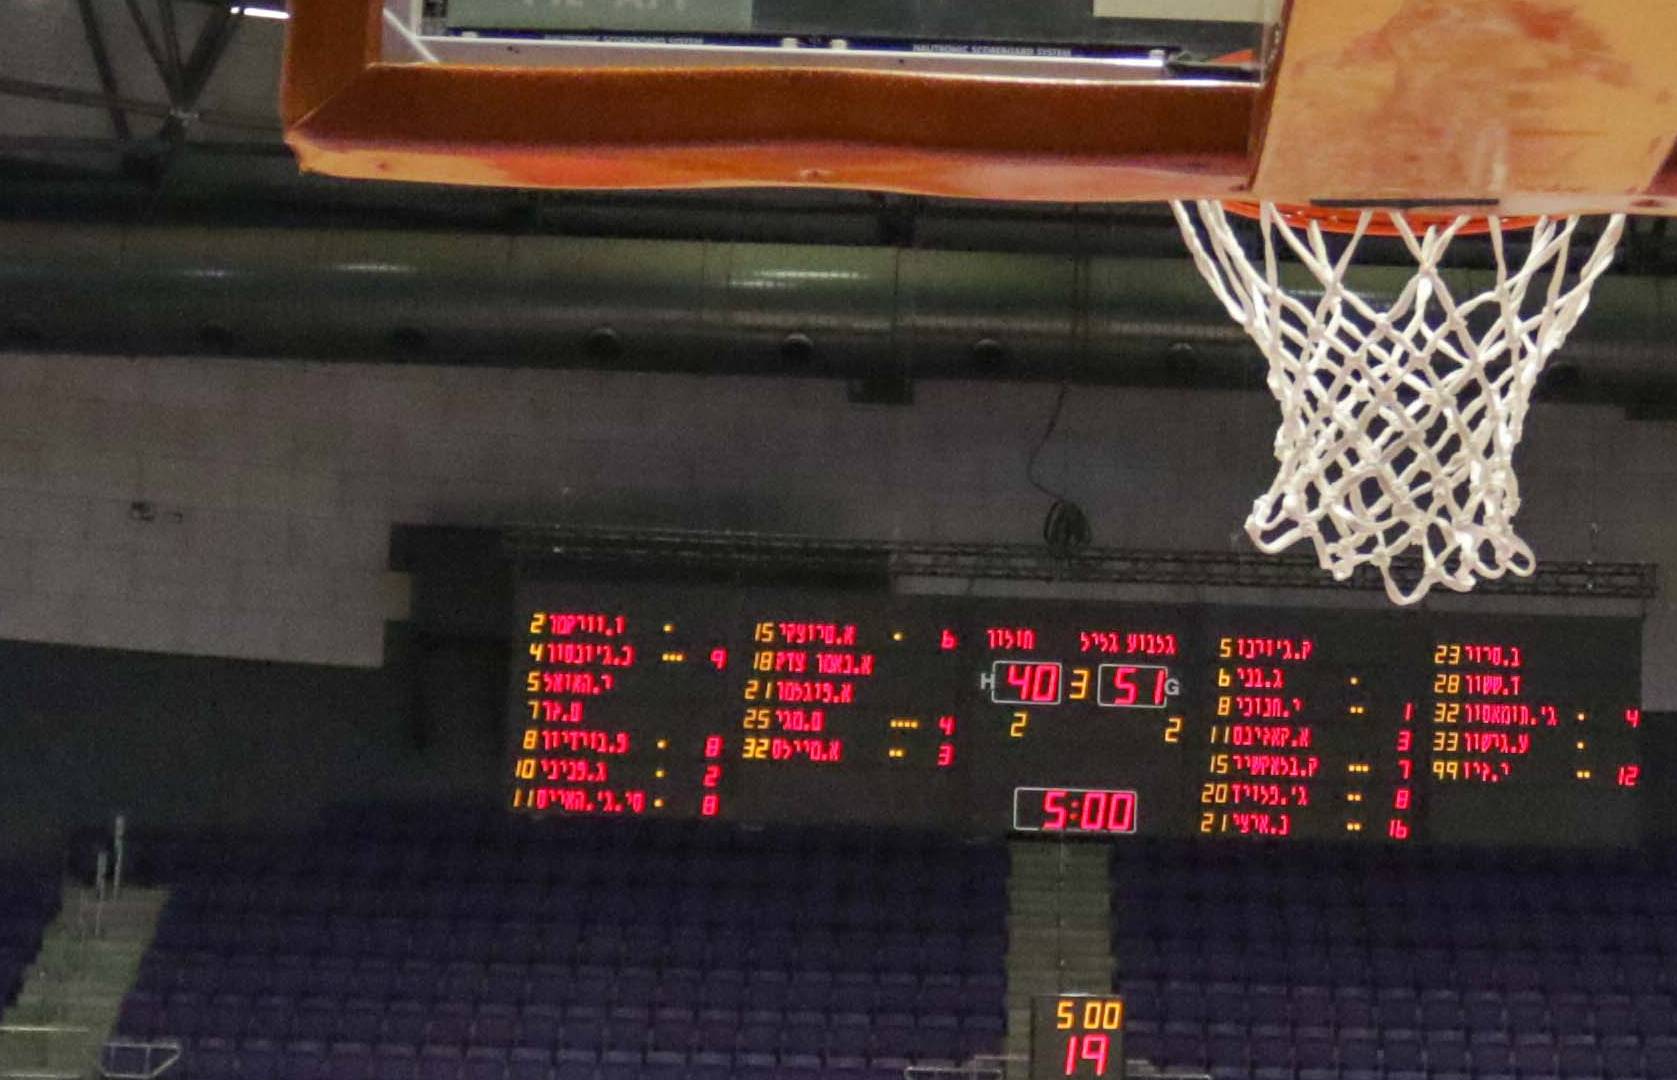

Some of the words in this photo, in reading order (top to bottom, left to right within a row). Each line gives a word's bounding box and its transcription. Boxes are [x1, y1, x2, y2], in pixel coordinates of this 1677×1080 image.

[530, 613, 547, 633] 2
[755, 622, 774, 642] 15
[941, 630, 957, 649] 6
[530, 644, 545, 661] 4
[711, 649, 727, 669] 9
[1221, 638, 1232, 657] 5
[1435, 645, 1460, 665] 23
[754, 651, 775, 671] 18
[528, 671, 541, 691] 5
[745, 680, 772, 699] 21
[1008, 662, 1060, 704] 40
[1070, 669, 1090, 699] 3
[1114, 665, 1168, 706] 51
[1218, 668, 1231, 687] 6
[1434, 674, 1460, 694] 28
[529, 700, 541, 718] 7
[1217, 696, 1232, 715] 8
[1405, 703, 1412, 720] 1
[1435, 703, 1460, 723] 32
[1626, 710, 1640, 727] 4
[743, 709, 771, 729] 25
[939, 717, 955, 735] 4
[1011, 712, 1027, 736] 2
[1165, 718, 1181, 742] 2
[523, 729, 539, 750] 8
[705, 736, 723, 757] 8
[742, 736, 770, 759] 32
[938, 744, 954, 766] 3
[1211, 727, 1230, 741] 11
[1397, 730, 1412, 751] 3
[1434, 732, 1459, 751] 33
[516, 758, 537, 779] 10
[703, 765, 721, 788] 2
[1211, 754, 1228, 774] 15
[1399, 759, 1412, 779] 7
[1433, 760, 1458, 778] 99
[1618, 765, 1640, 786] 12
[514, 789, 535, 807] 11
[702, 793, 719, 815] 8
[1202, 783, 1229, 803] 20
[1395, 788, 1411, 809] 8
[1042, 791, 1135, 831] 5:00
[1201, 812, 1227, 832] 21
[1389, 819, 1409, 839] 16
[1065, 1033, 1109, 1075] 19
